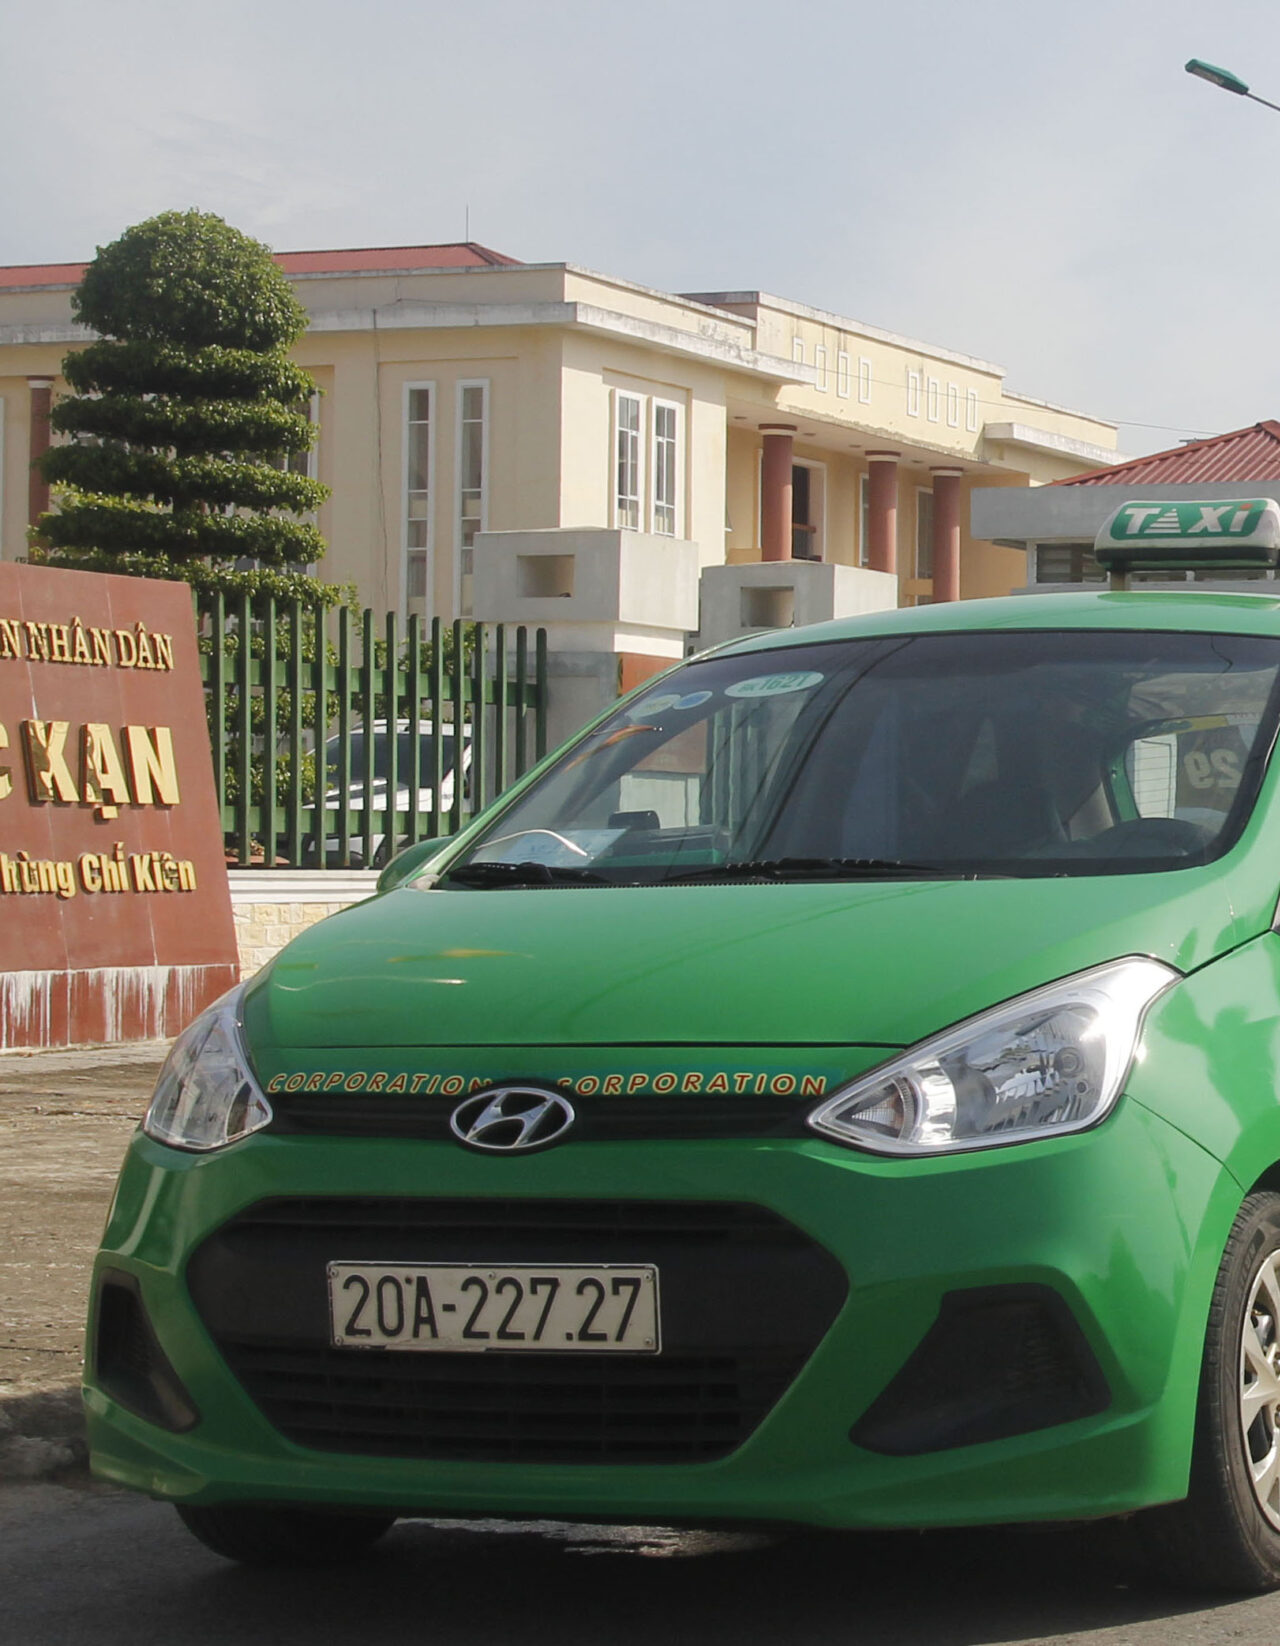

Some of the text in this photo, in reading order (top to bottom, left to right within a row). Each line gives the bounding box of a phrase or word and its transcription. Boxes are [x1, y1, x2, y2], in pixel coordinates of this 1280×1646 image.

[25, 616, 112, 665] NHÂN
[114, 621, 174, 670] DÂN
[24, 719, 181, 819] KẠN
[0, 841, 197, 898] hùng Chí Kiên
[342, 1274, 642, 1342] 20A-227.27
